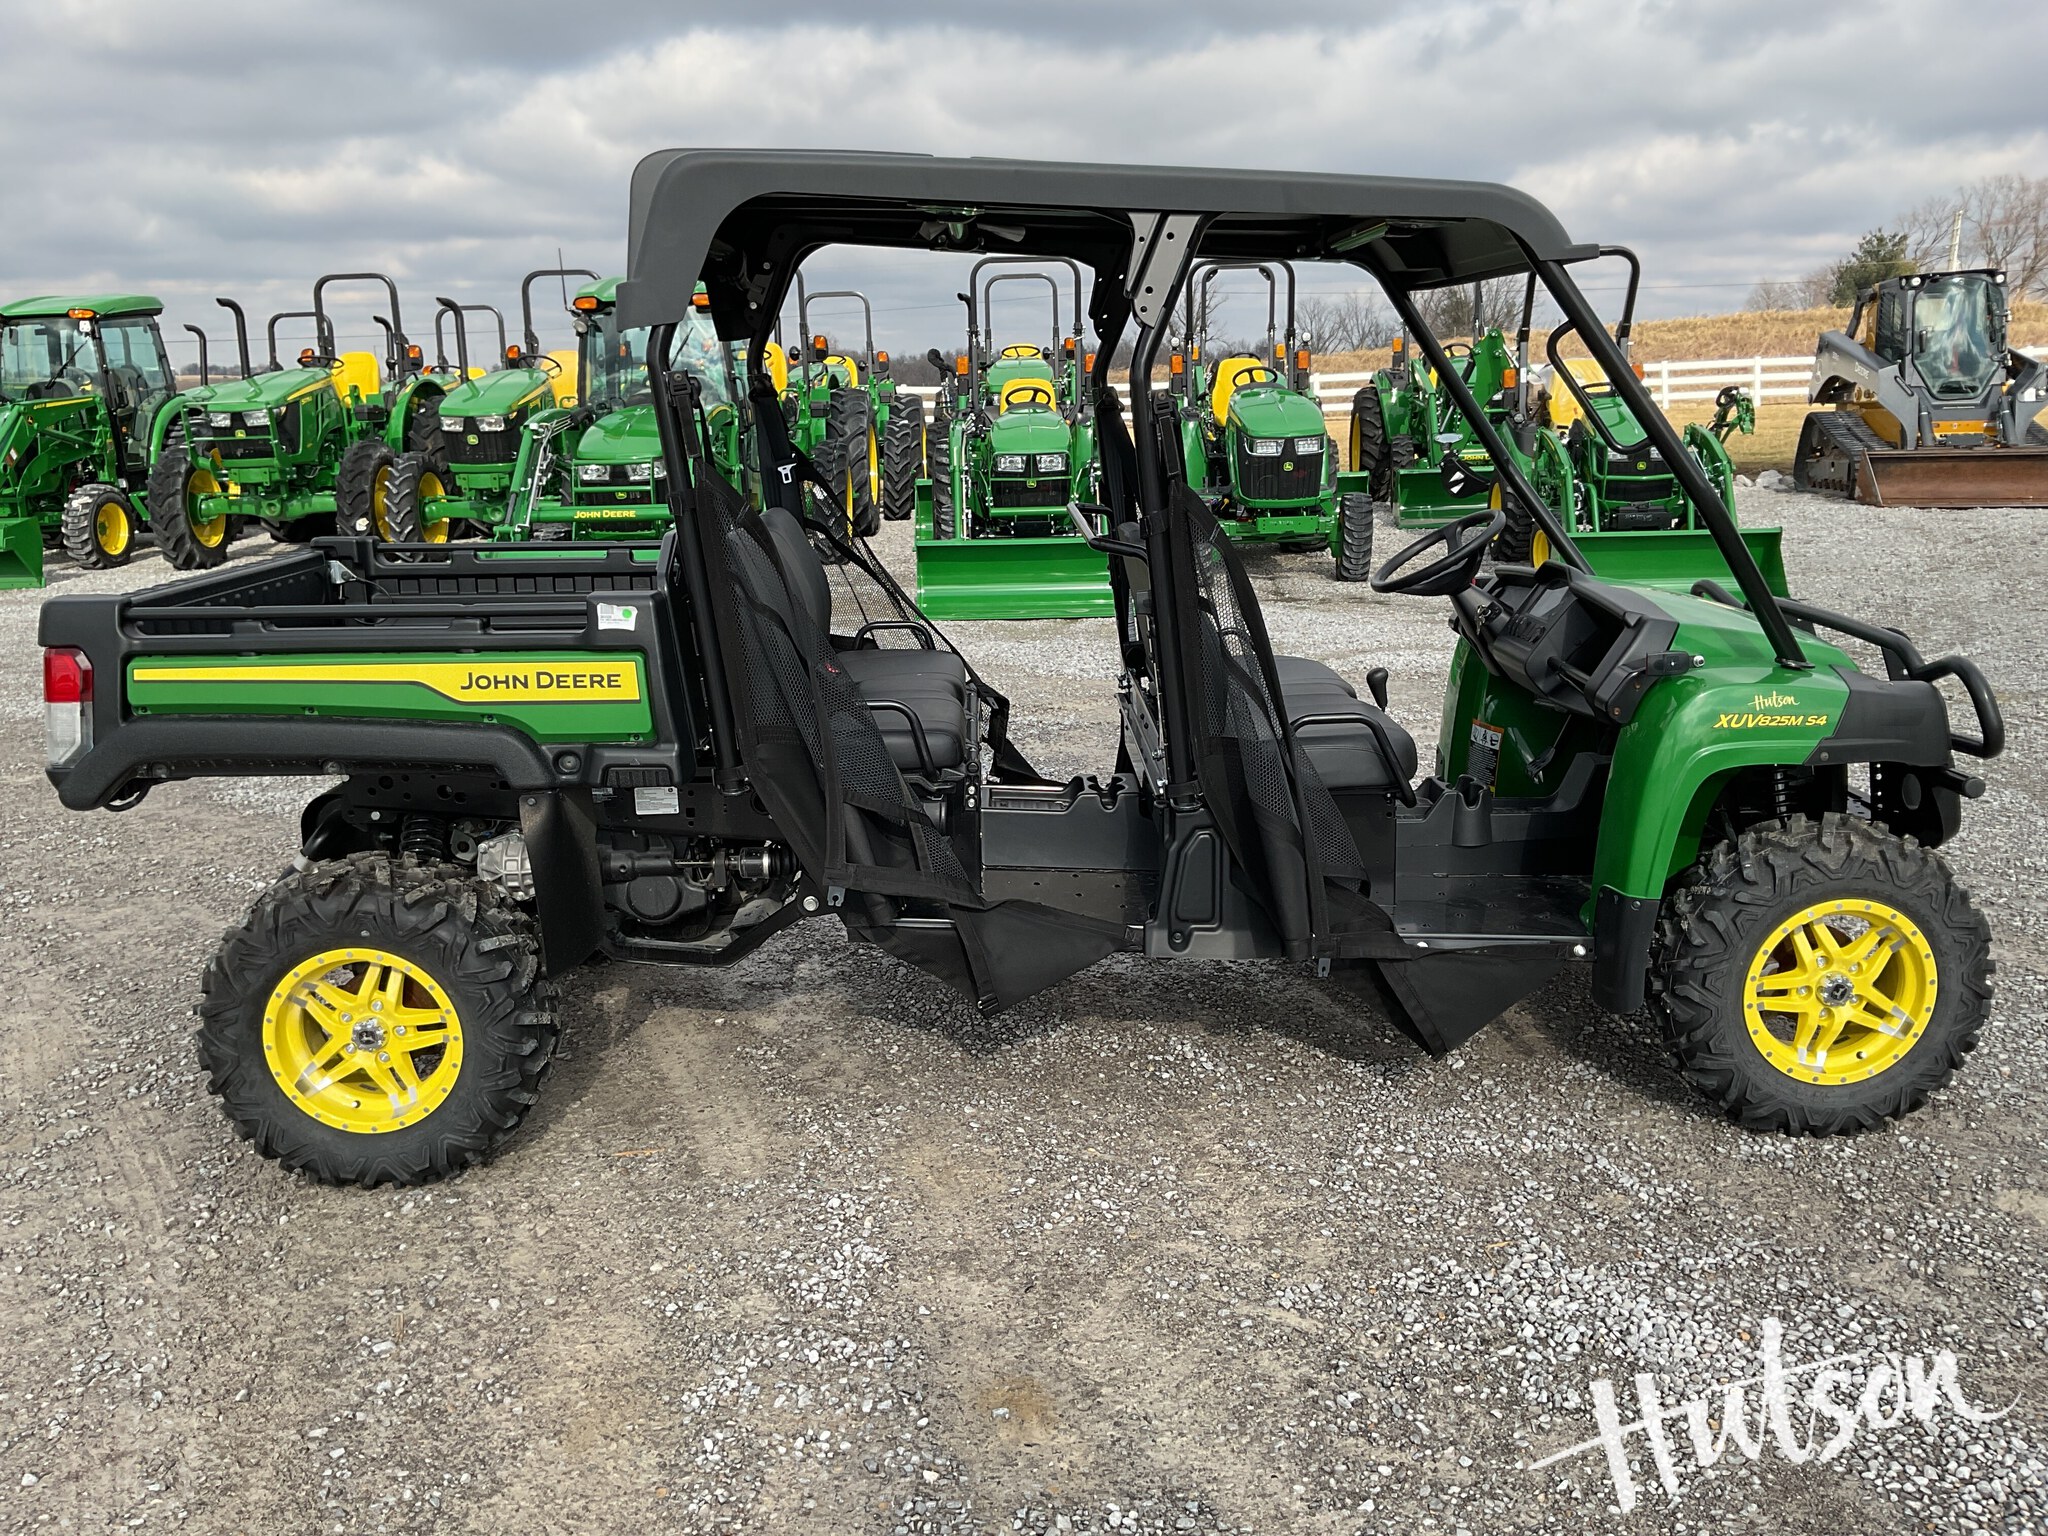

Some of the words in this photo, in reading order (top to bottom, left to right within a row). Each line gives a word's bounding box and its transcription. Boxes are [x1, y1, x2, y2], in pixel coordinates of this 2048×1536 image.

[573, 510, 601, 519] JOHN
[602, 509, 637, 518] DEERE
[460, 671, 529, 690] JOHN
[535, 671, 622, 689] DEERE
[1747, 690, 1801, 711] Hutson
[1713, 713, 1805, 728] XUV825M
[1805, 715, 1828, 726] S4
